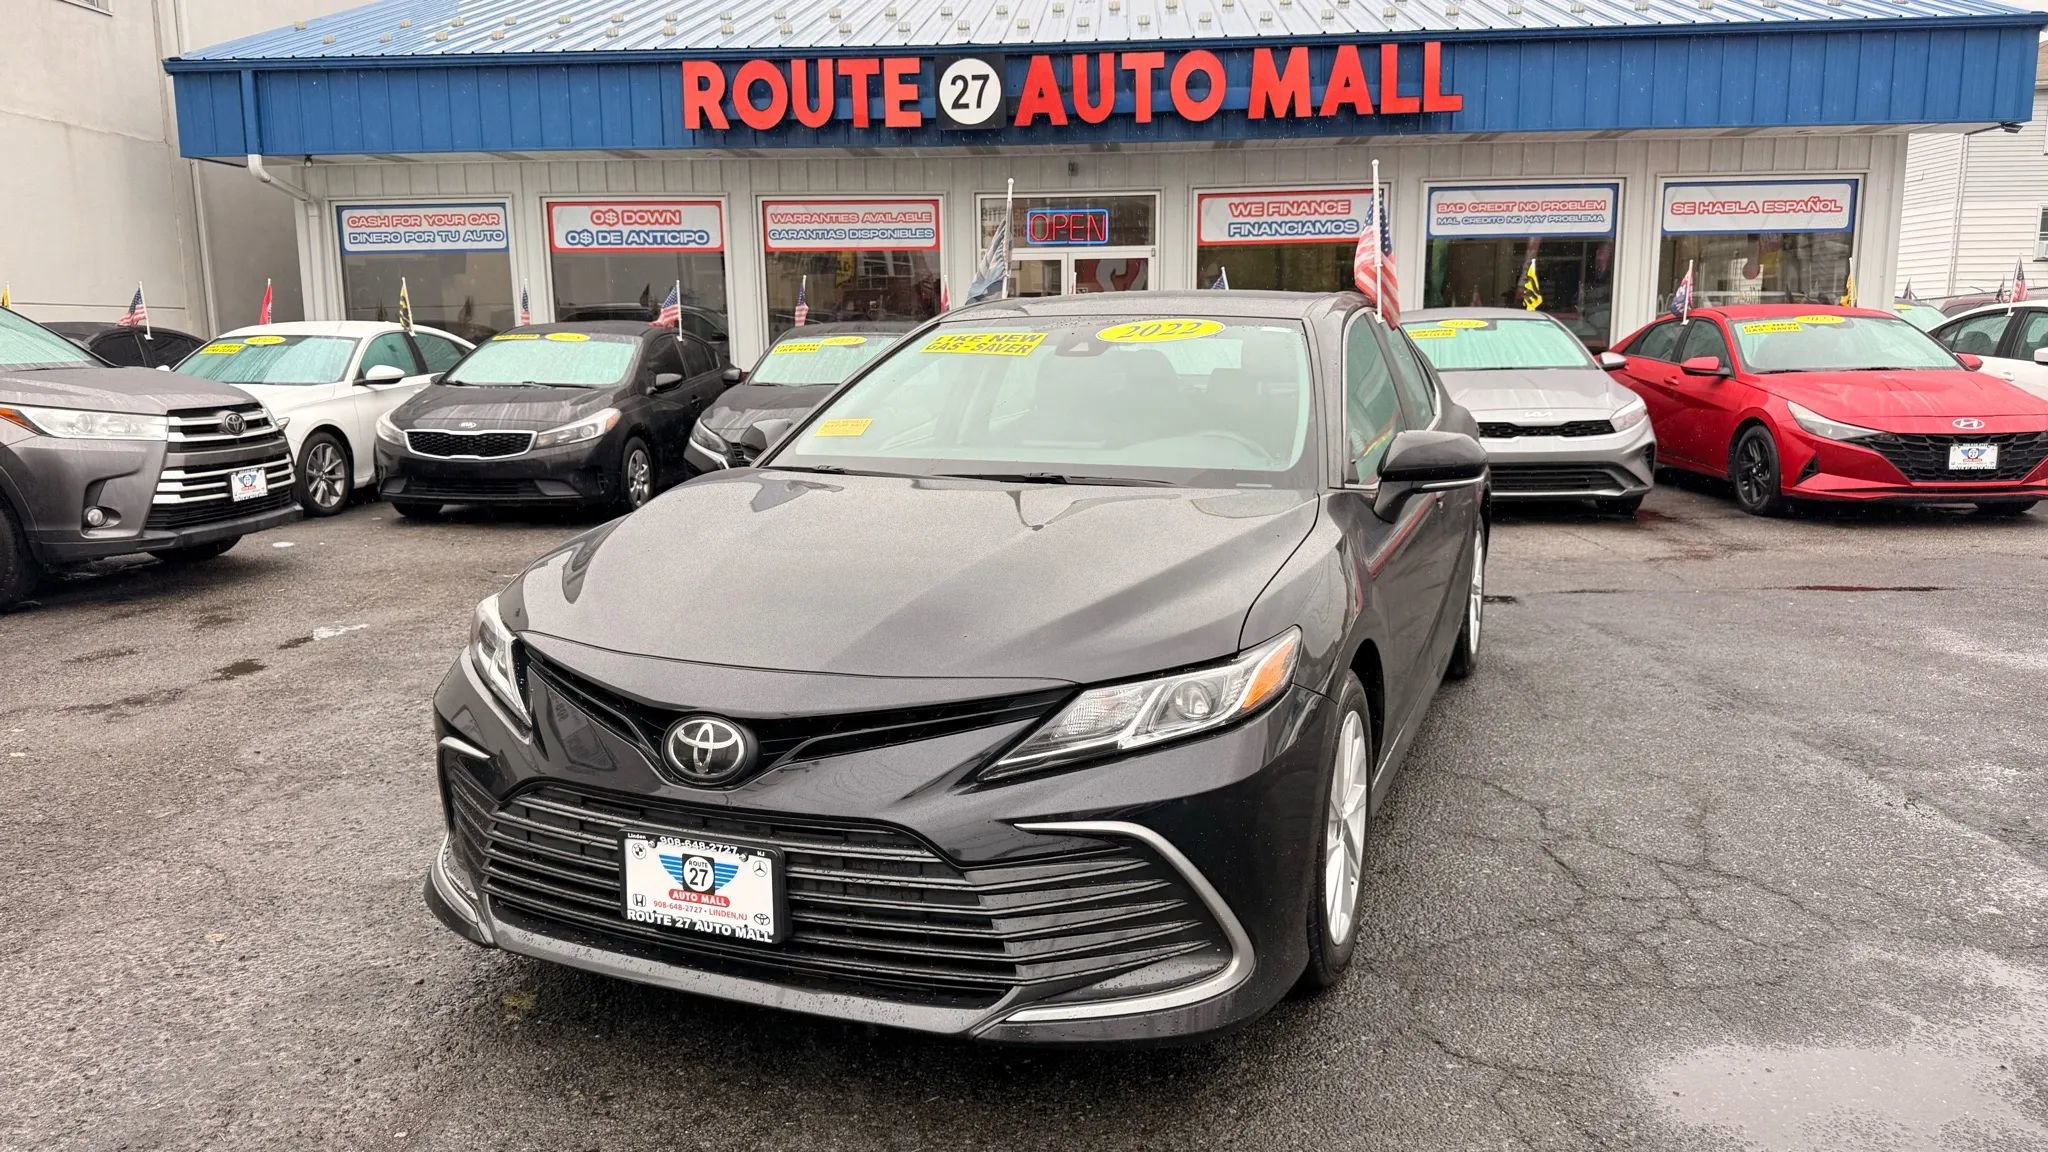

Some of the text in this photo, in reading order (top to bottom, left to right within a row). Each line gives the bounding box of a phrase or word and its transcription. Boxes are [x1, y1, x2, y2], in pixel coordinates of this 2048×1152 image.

[682, 41, 1464, 130] ROUTE 27 AUTO MALL
[1229, 200, 1352, 218] WE FINANCE
[1437, 200, 1606, 214] BAD CREDIT NO PROBLEM
[1671, 196, 1843, 215] SE HABLA ESPAÑOL
[348, 213, 500, 228] CASH FOR YOUR CAR
[622, 210, 682, 226] DOWN
[862, 212, 932, 223] AVAILABLE
[1437, 214, 1604, 226] MAL CREDITO NO HAY PROBLEMA
[769, 228, 935, 240] GARANTIAS DISPONIBLES
[1030, 214, 1106, 241] OPEN
[1229, 220, 1359, 238] FINANCIAMOS
[349, 230, 504, 244] DINERO POR TU AUTO
[596, 230, 623, 246] DE
[626, 230, 710, 246] ANTICIPO
[936, 334, 1044, 342] LIKE NEW
[1116, 322, 1203, 339] 2022
[628, 832, 646, 840] Linden
[660, 836, 738, 855] 908-648-2727
[688, 860, 708, 868] ROUTE
[689, 867, 708, 888] 27
[654, 901, 703, 914] 908-648-2727
[672, 892, 727, 908] AUTO MALL
[627, 910, 772, 943] ROUTE 27 AUTO MALL
